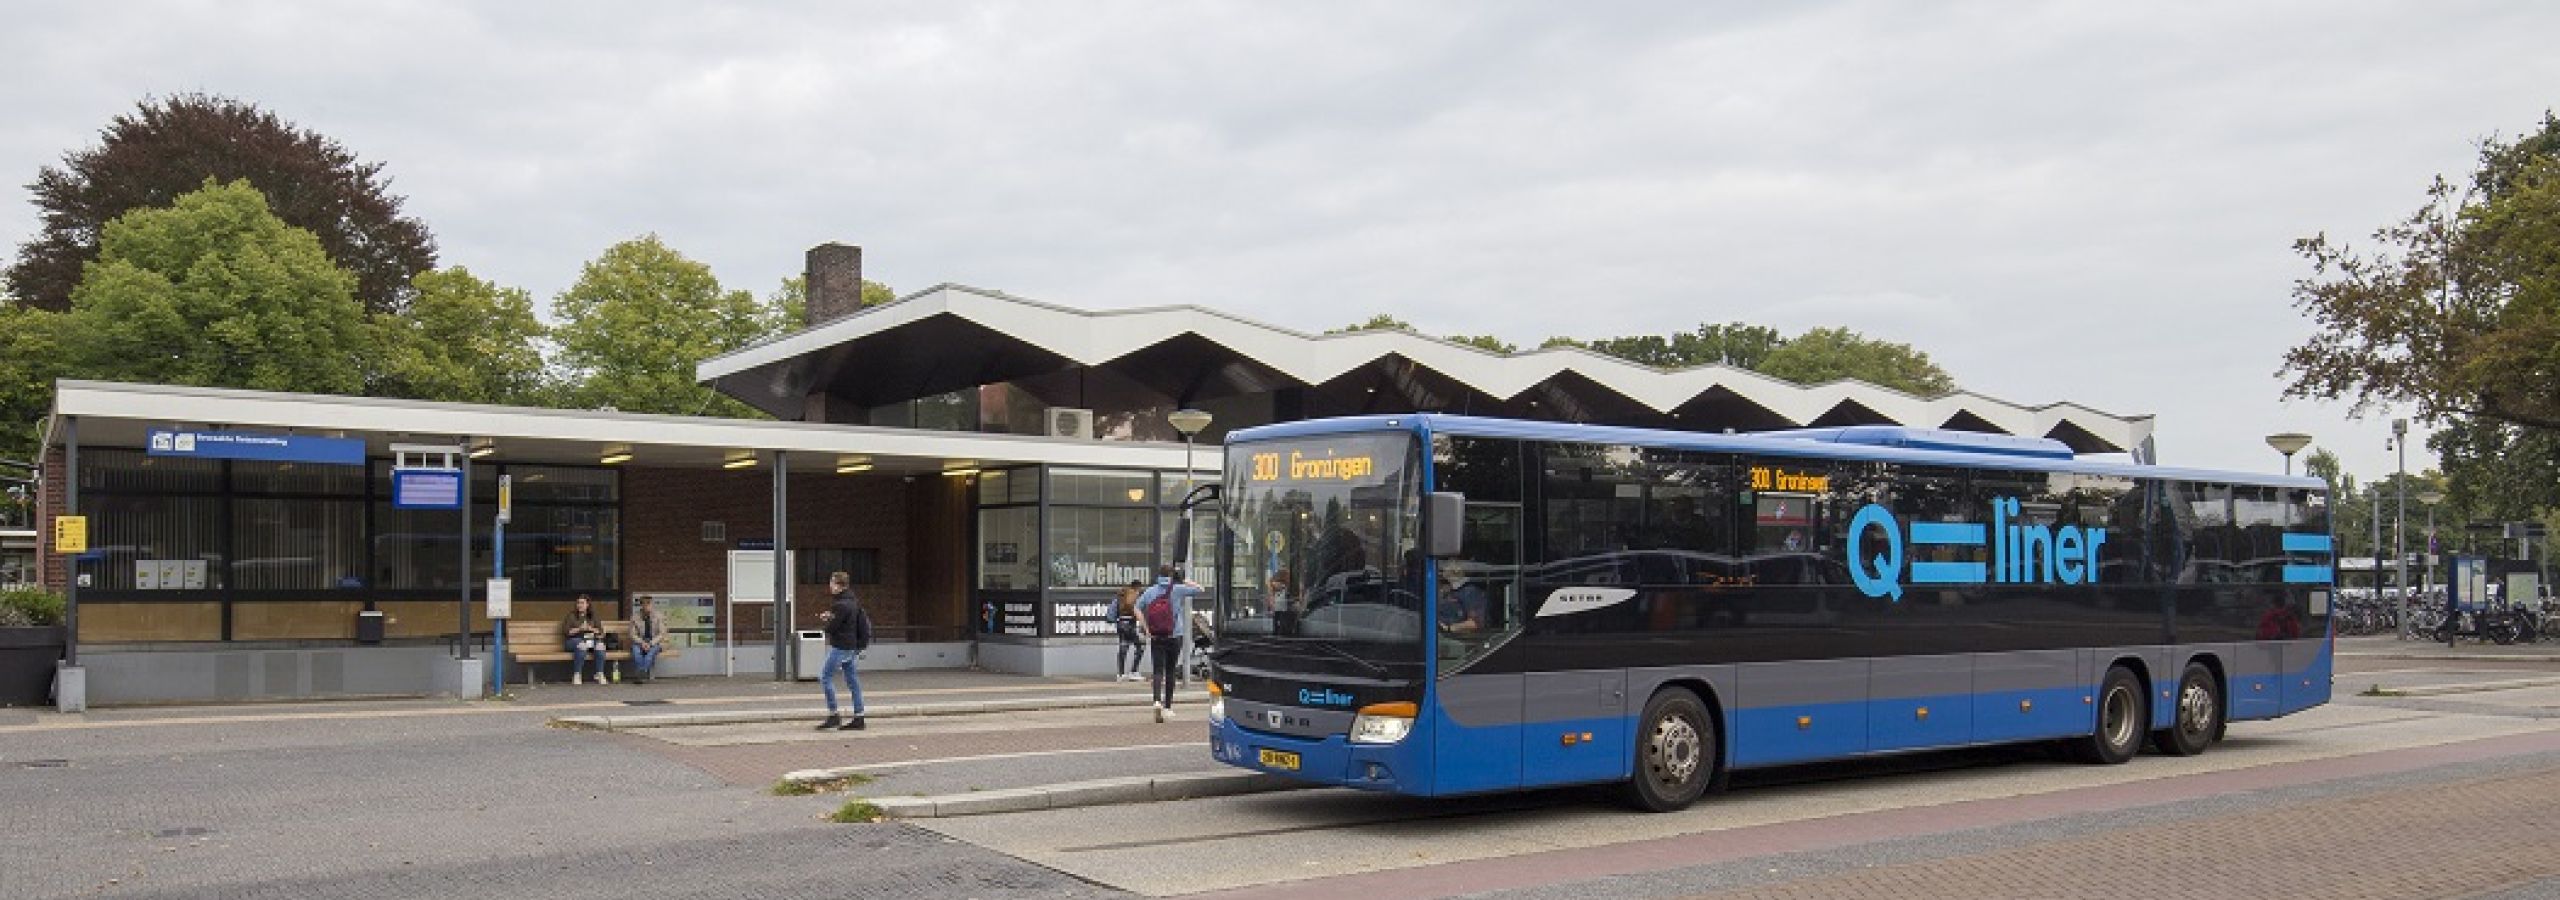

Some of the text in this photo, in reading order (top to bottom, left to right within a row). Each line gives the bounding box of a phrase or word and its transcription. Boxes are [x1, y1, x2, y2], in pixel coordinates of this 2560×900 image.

[1252, 448, 1371, 480] 300 Groningen
[1077, 562, 1150, 585] Welkom
